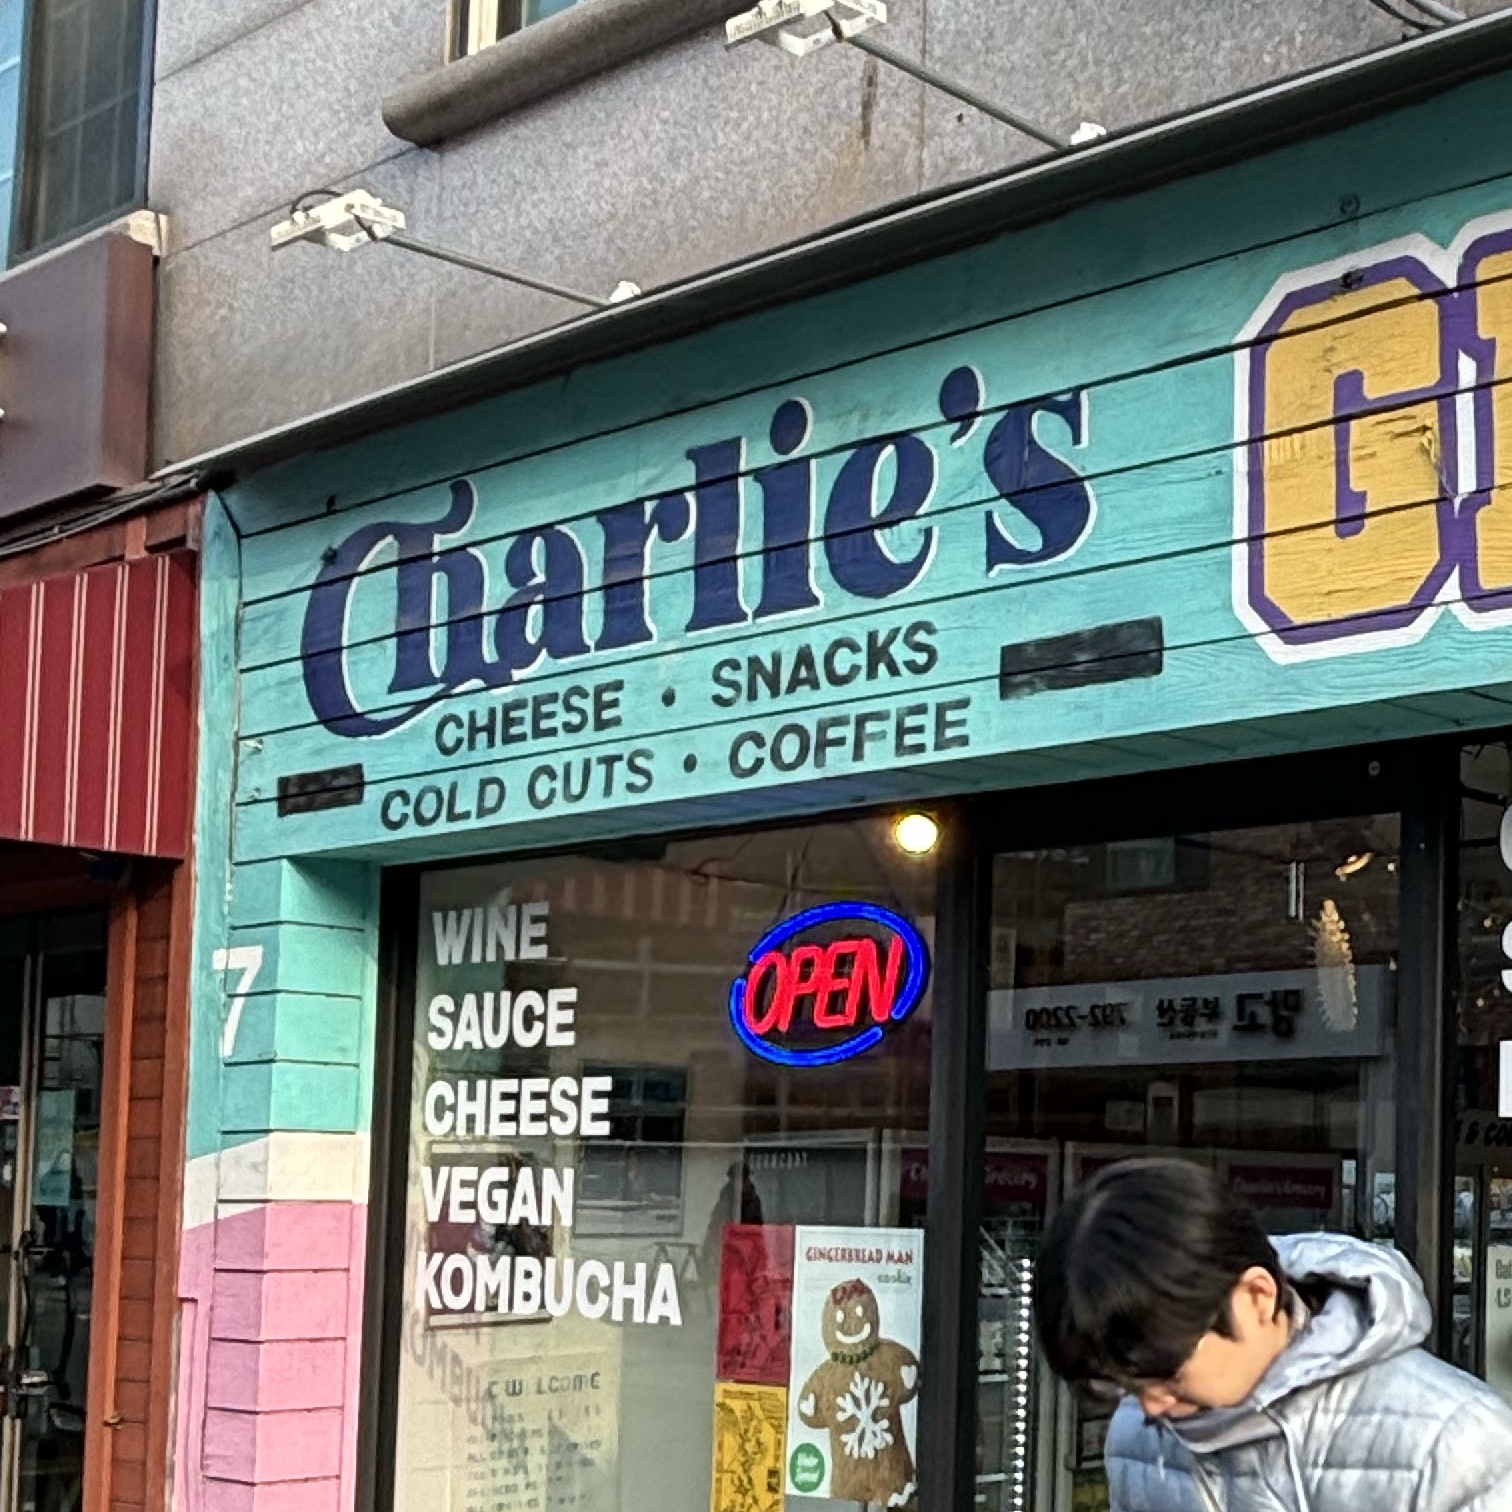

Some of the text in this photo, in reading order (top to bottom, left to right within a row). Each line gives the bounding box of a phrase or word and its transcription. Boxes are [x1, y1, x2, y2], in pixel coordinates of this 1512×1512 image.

[299, 364, 1097, 740] Charlie's
[434, 619, 939, 757] CHEESE SNACKS
[379, 696, 972, 832] COLD CUTS COFFEE
[432, 902, 550, 967] WINE
[211, 945, 264, 1058] 7
[427, 985, 579, 1051] SAUCE
[743, 937, 904, 1036] OPEN
[424, 1076, 613, 1137] CHEESE
[420, 1165, 575, 1227] VEGAN
[416, 1251, 684, 1327] KOMBUCHA
[805, 1245, 914, 1266] GINGERBREAD MAN
